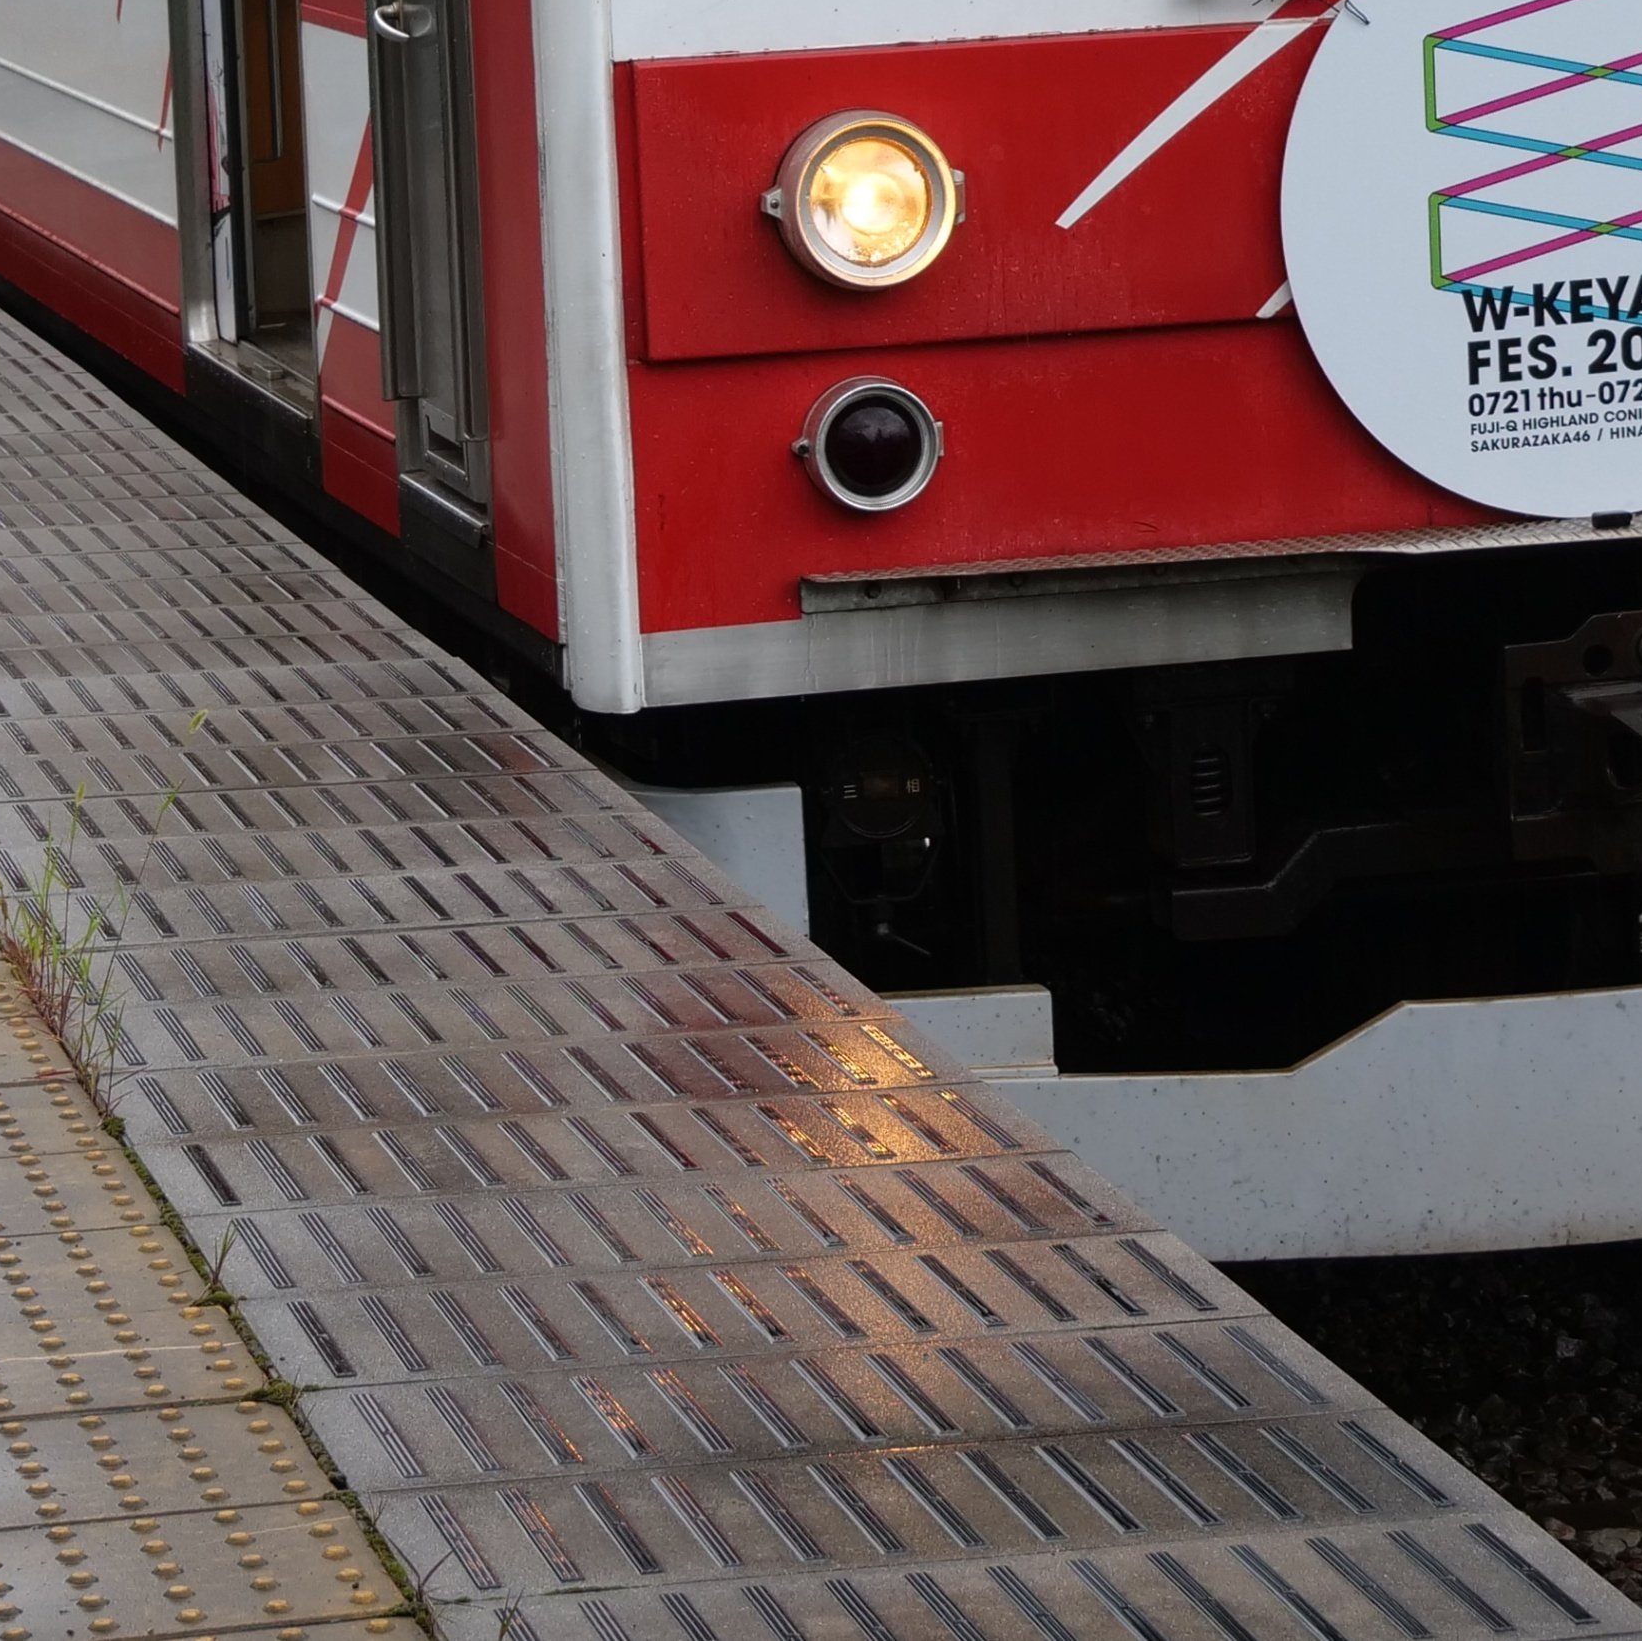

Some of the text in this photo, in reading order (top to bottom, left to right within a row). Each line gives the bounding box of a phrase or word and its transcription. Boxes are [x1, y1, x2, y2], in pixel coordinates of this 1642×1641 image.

[1467, 334, 1572, 385] FES.
[1470, 419, 1518, 435] FUJI-Q
[1523, 412, 1599, 431] HIGHLAND
[1470, 429, 1591, 453] SAKURAZAKA46
